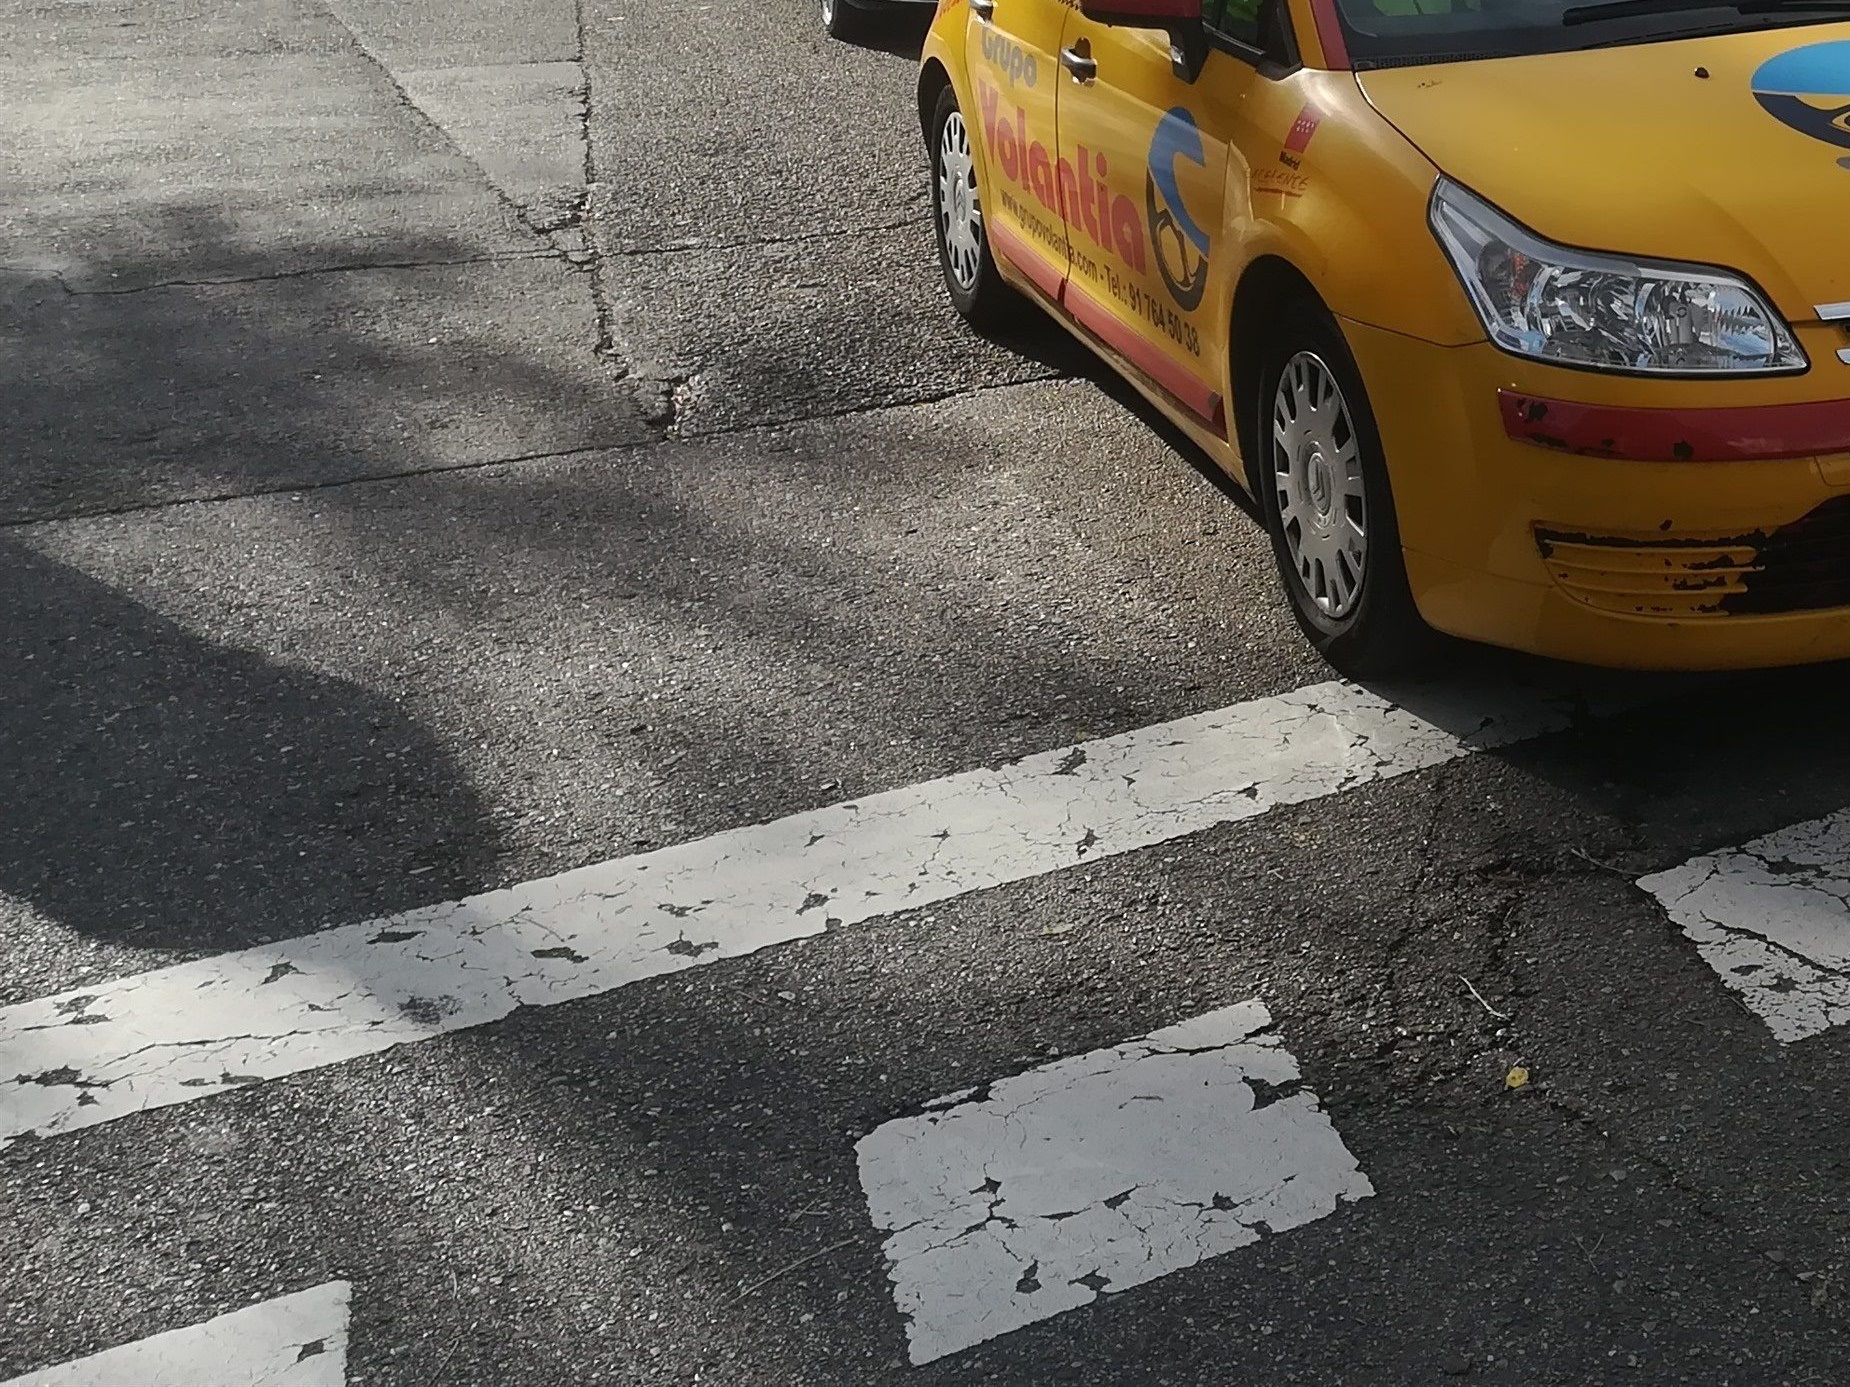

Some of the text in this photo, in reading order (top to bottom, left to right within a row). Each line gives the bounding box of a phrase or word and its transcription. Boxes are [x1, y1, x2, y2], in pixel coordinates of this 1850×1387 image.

[980, 26, 1038, 89] Grupo
[977, 77, 1147, 276] Volantia
[1128, 282, 1143, 316] 91
[1144, 293, 1167, 334] 764
